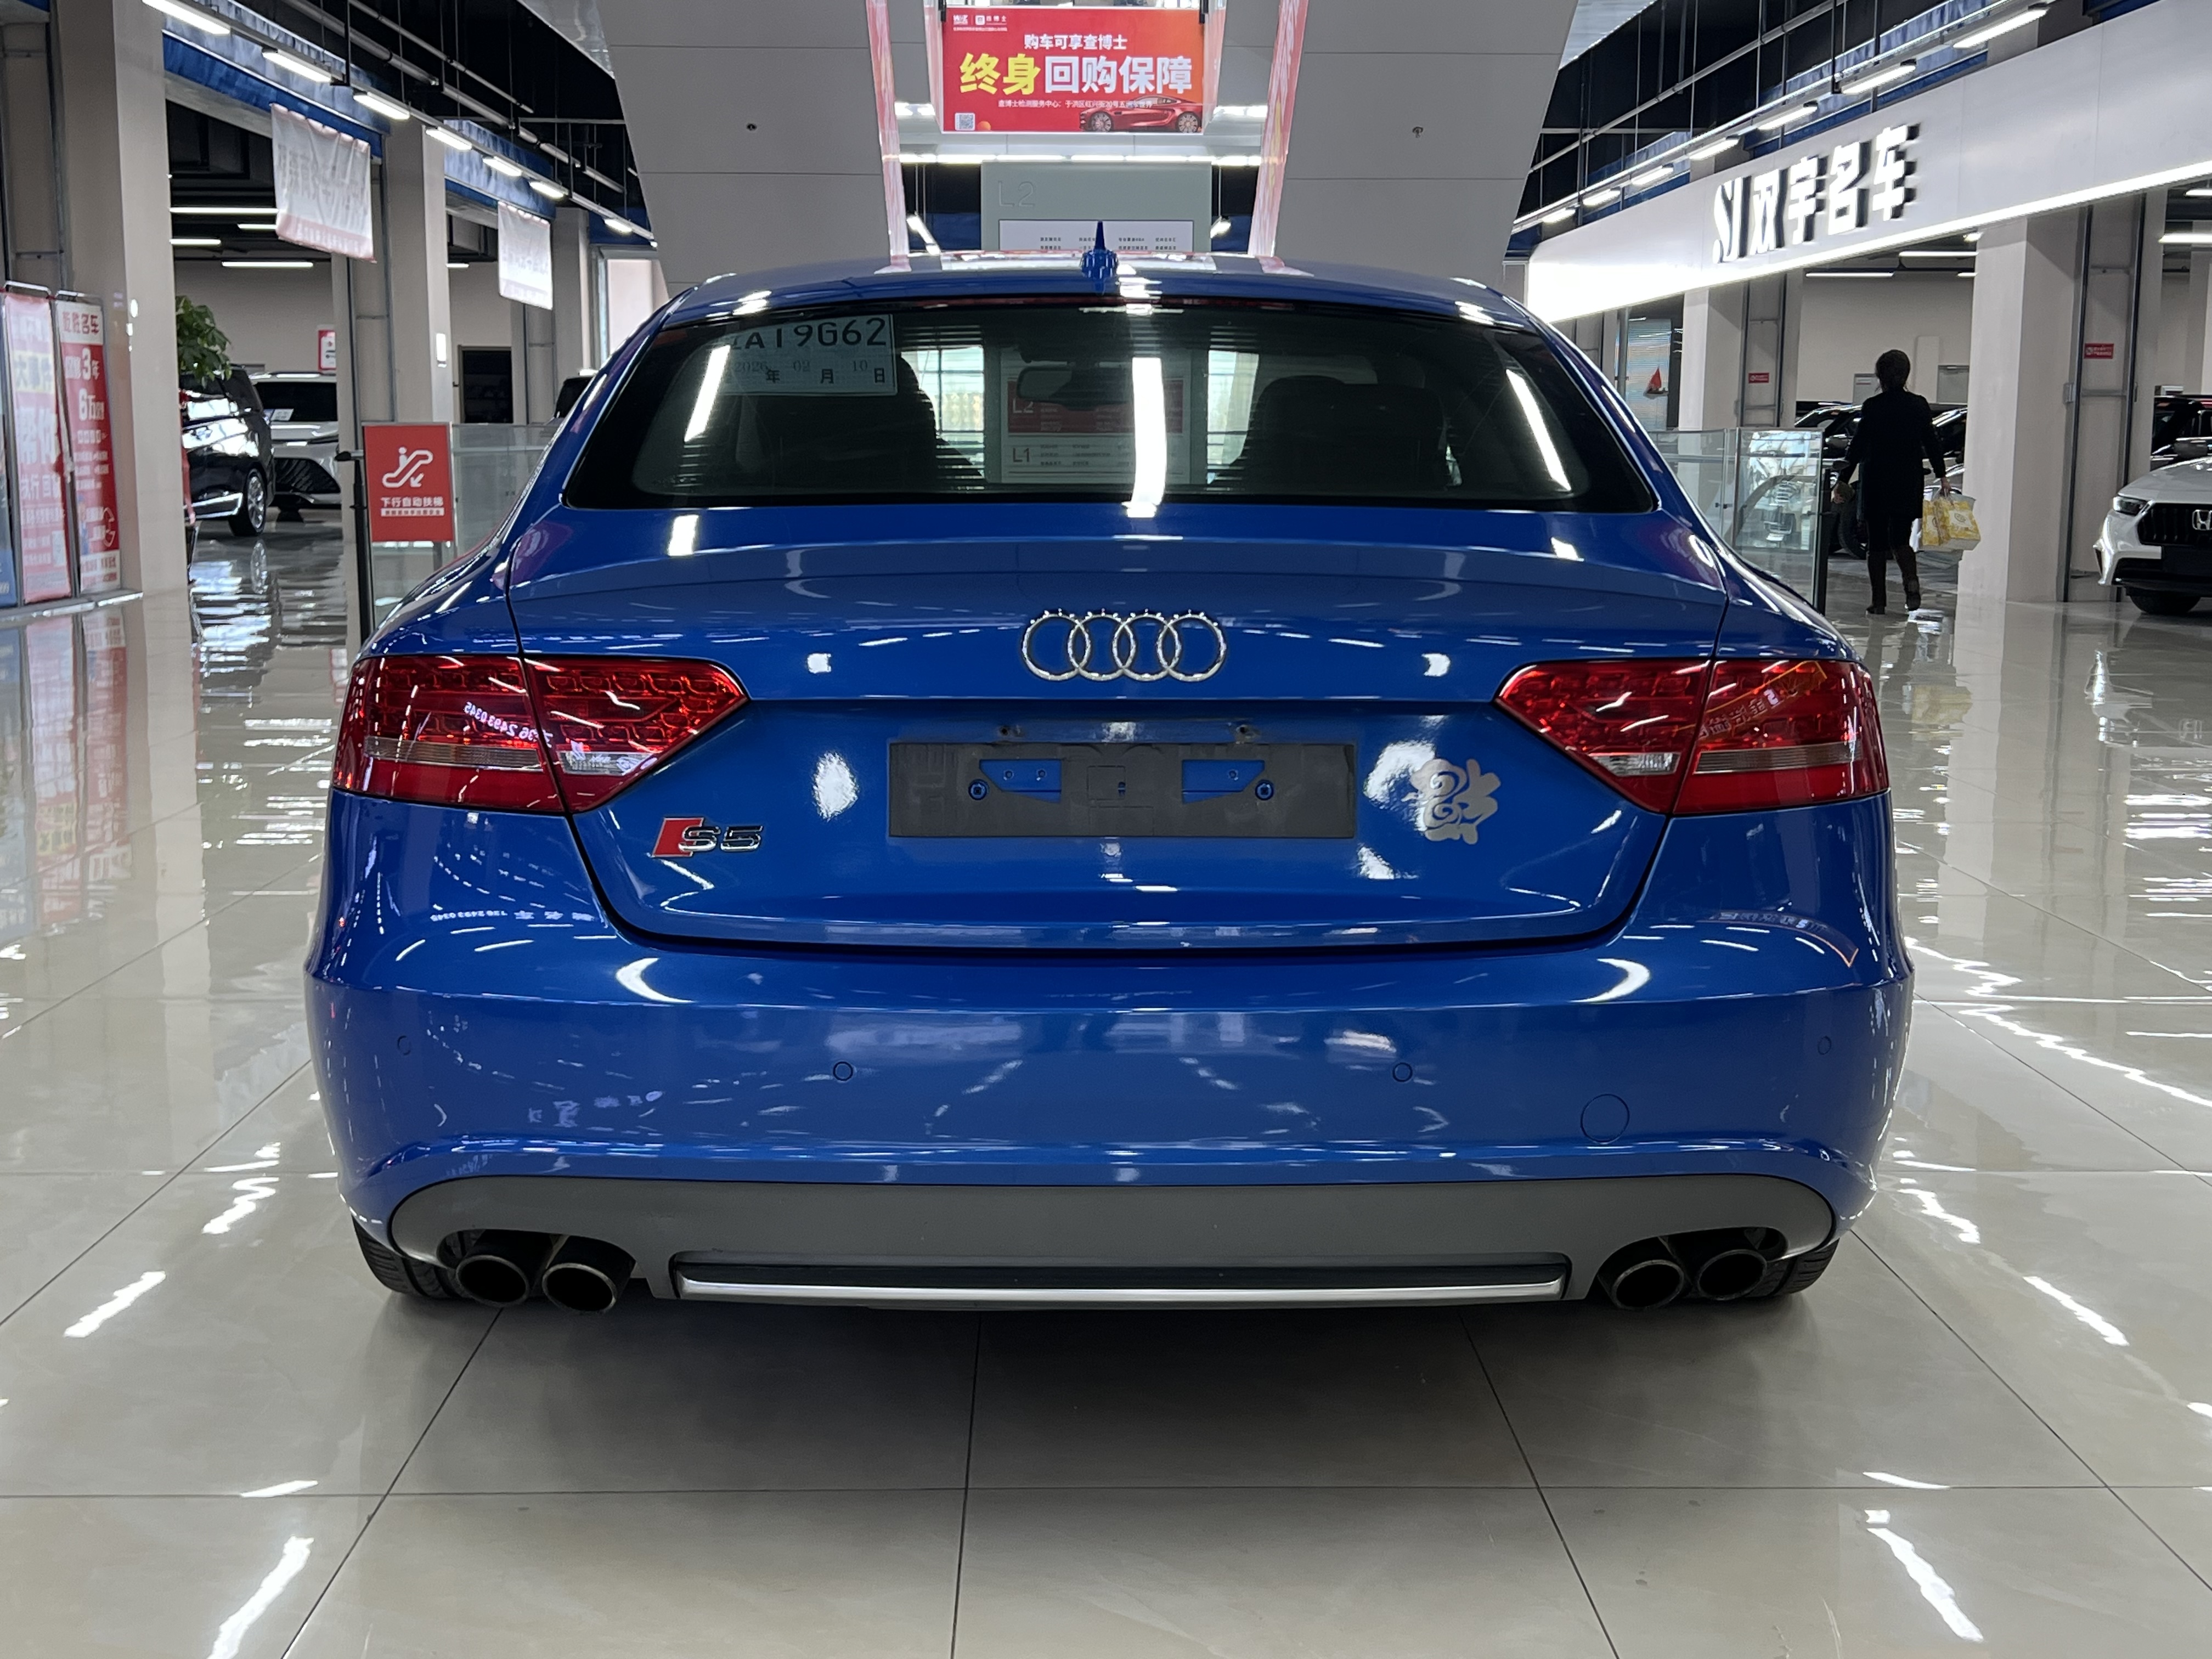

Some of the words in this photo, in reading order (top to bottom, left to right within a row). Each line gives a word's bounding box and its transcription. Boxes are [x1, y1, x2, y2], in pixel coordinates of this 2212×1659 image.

[1024, 34, 1127, 50] 购车可享查博士
[960, 53, 1192, 95] 终身回购保障
[998, 180, 1035, 207] L2
[766, 368, 780, 383] 年
[821, 369, 834, 384] 月
[874, 368, 885, 383] 日
[1013, 448, 1030, 462] L1
[381, 496, 444, 507] 下行自动扶梯
[678, 825, 764, 853] S5
